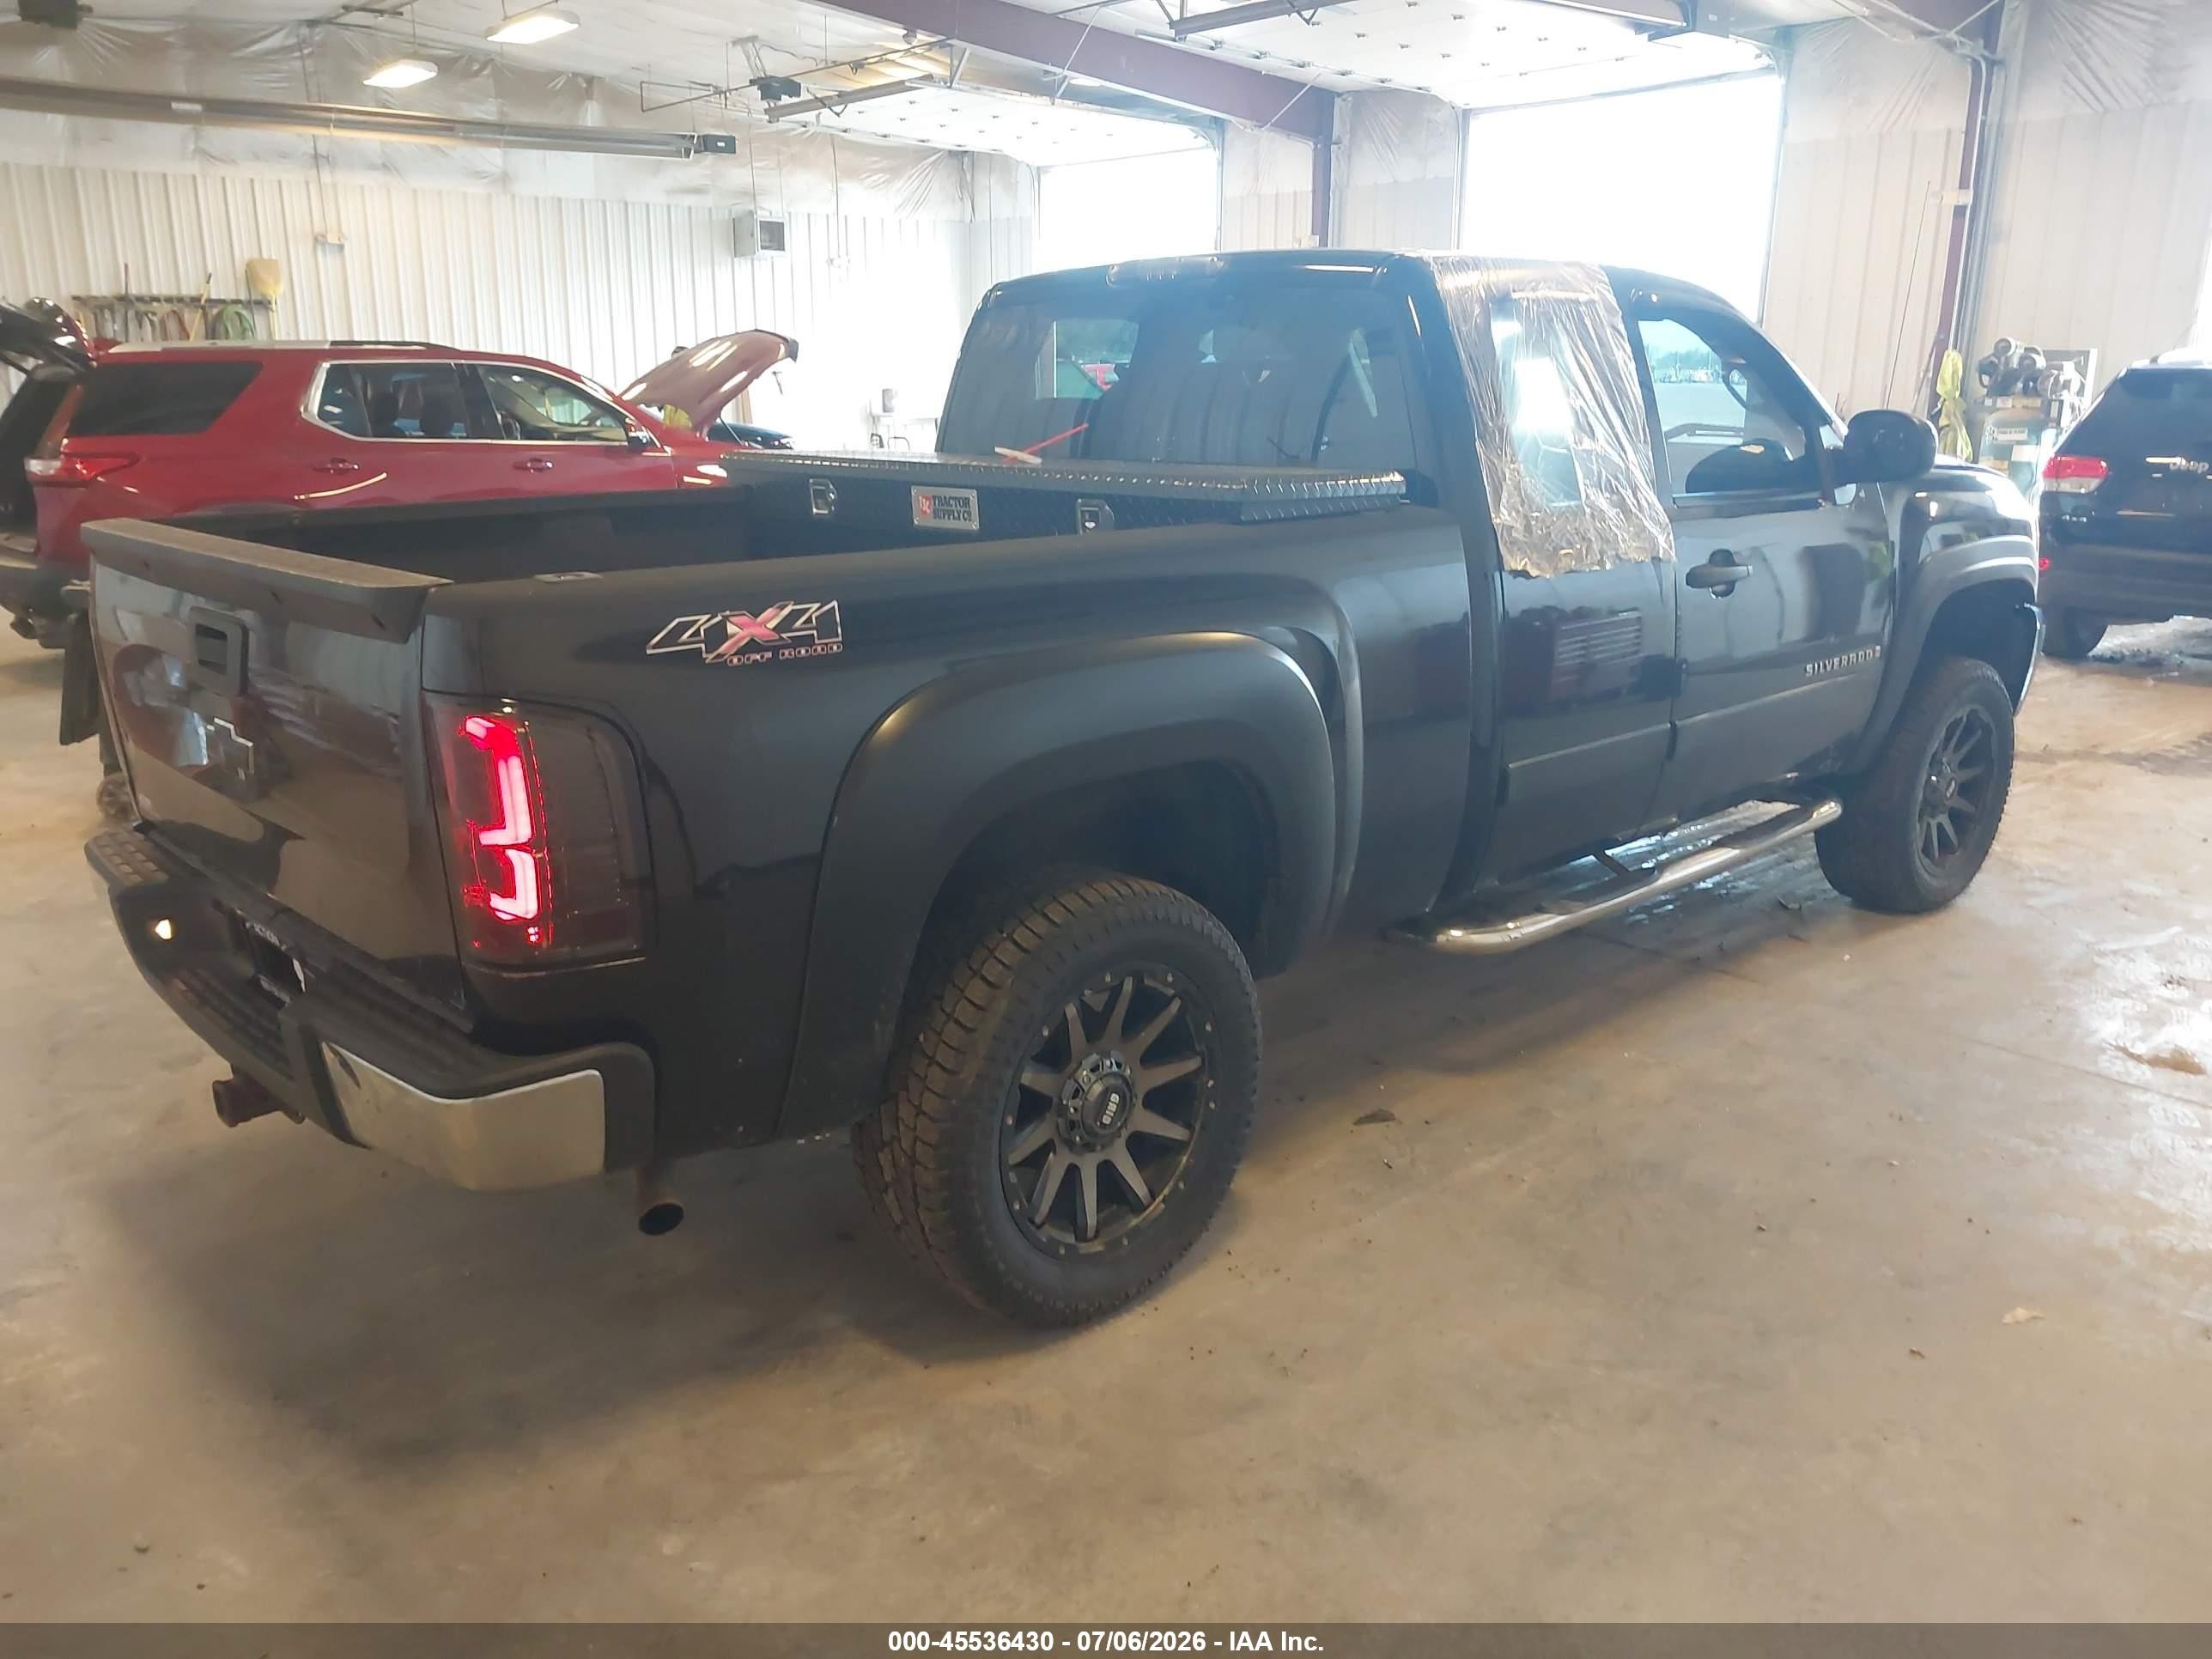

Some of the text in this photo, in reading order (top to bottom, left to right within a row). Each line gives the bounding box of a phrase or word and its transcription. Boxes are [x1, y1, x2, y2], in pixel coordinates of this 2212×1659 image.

[933, 495, 971, 508] TRACTOR
[933, 507, 962, 521] SUPPLY
[727, 642, 843, 666] OFF ROAD
[1806, 645, 1881, 677] SILVERADO
[1102, 1092, 1120, 1125] GRID
